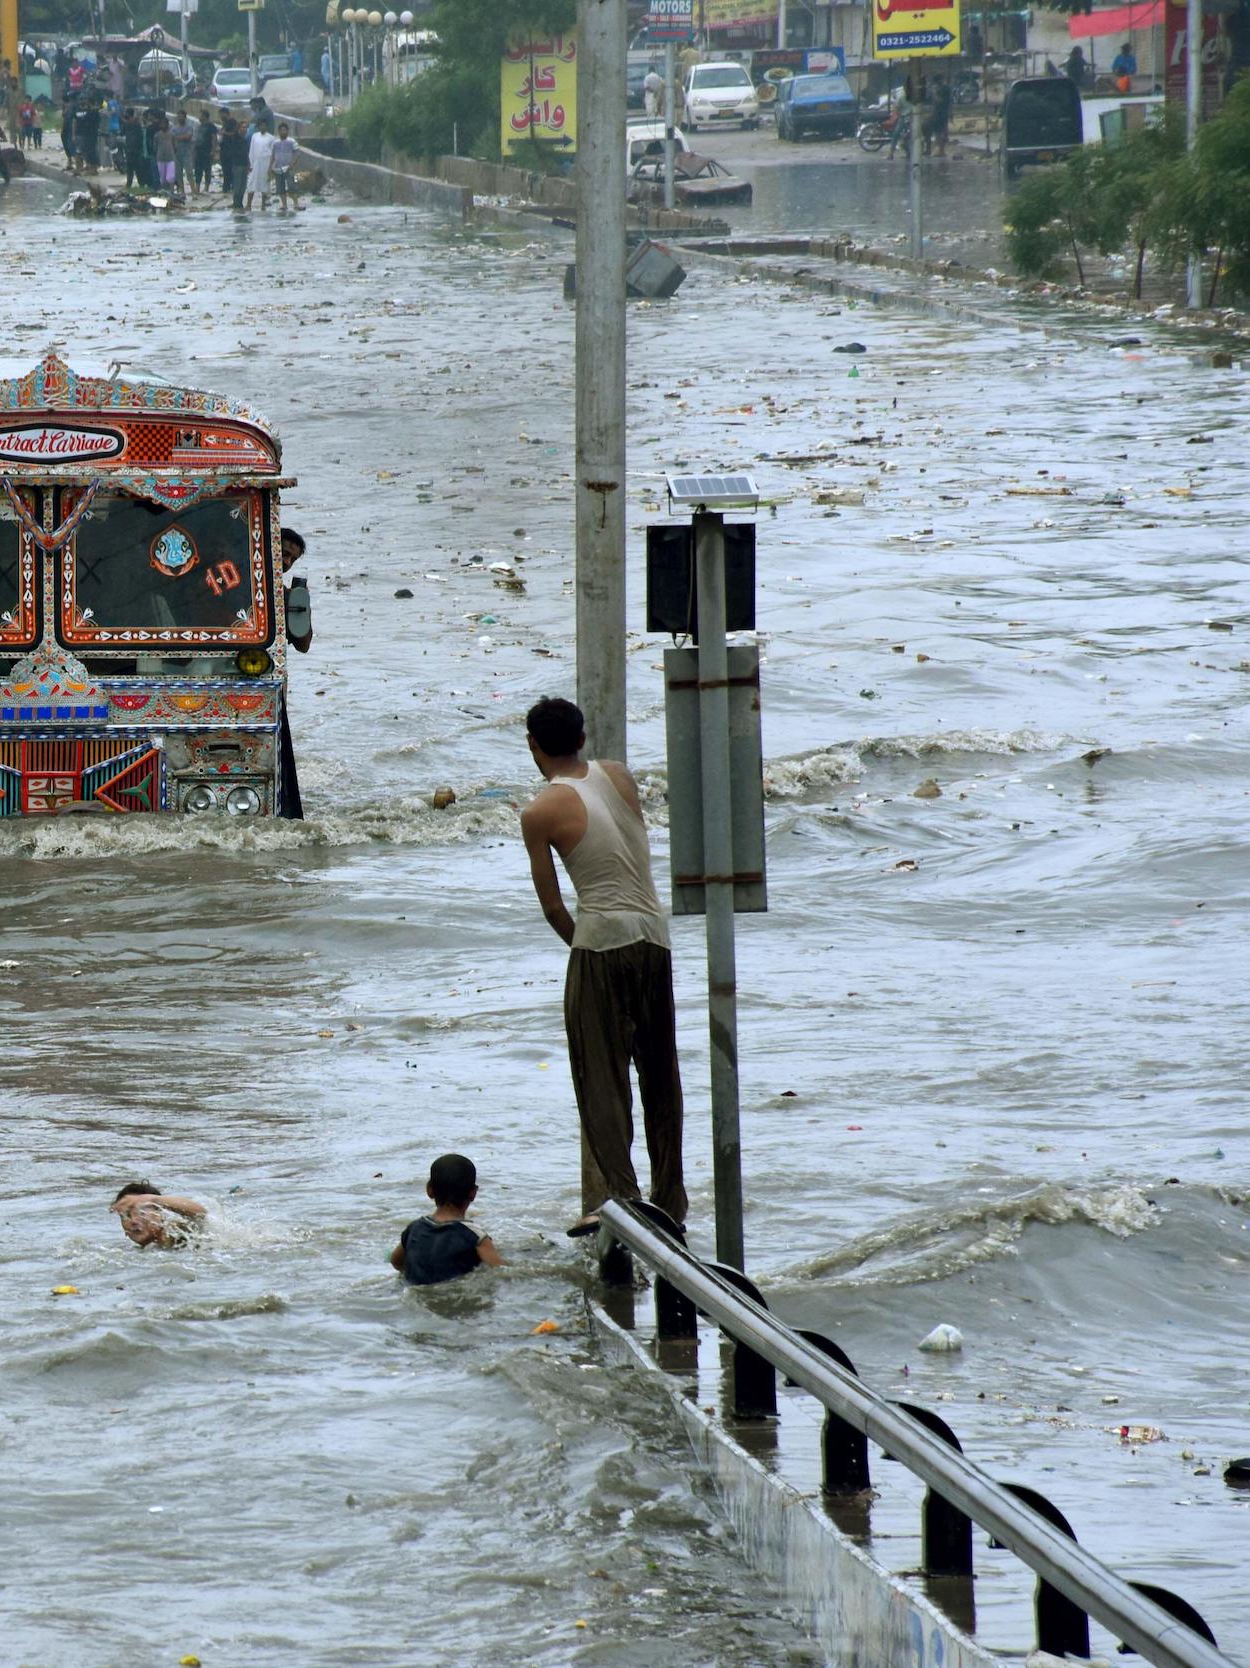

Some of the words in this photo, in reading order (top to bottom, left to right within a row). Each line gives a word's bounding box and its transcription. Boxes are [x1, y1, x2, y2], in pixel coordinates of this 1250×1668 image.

[650, 0, 691, 13] MOTORS
[880, 34, 950, 46] 0321-2522464
[516, 64, 557, 98] کار
[511, 99, 565, 131] واش
